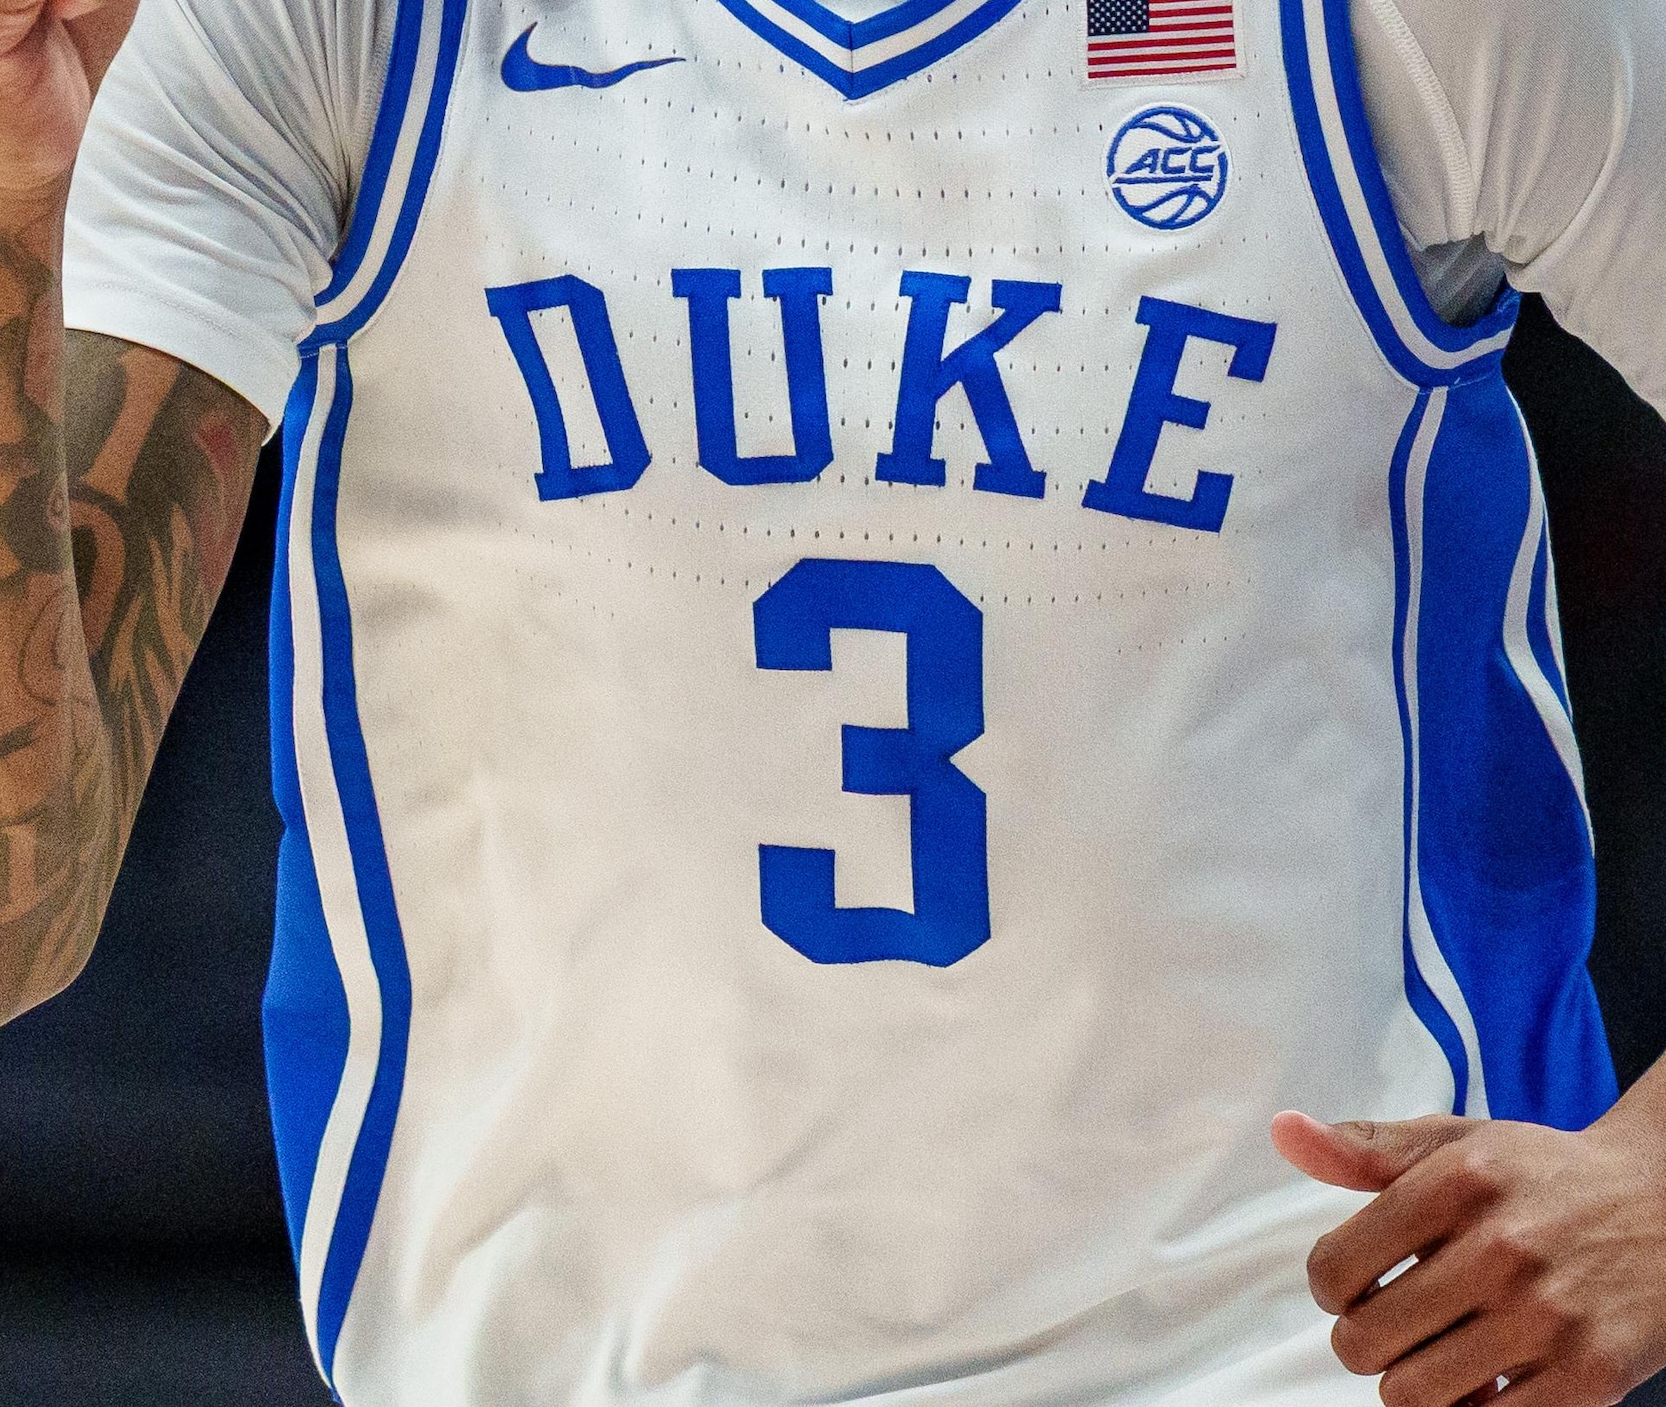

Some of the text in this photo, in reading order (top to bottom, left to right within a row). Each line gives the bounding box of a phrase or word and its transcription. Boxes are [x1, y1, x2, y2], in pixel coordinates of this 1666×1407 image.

[1125, 145, 1221, 175] ACC
[485, 266, 1277, 533] DUKE
[753, 558, 991, 967] 3
